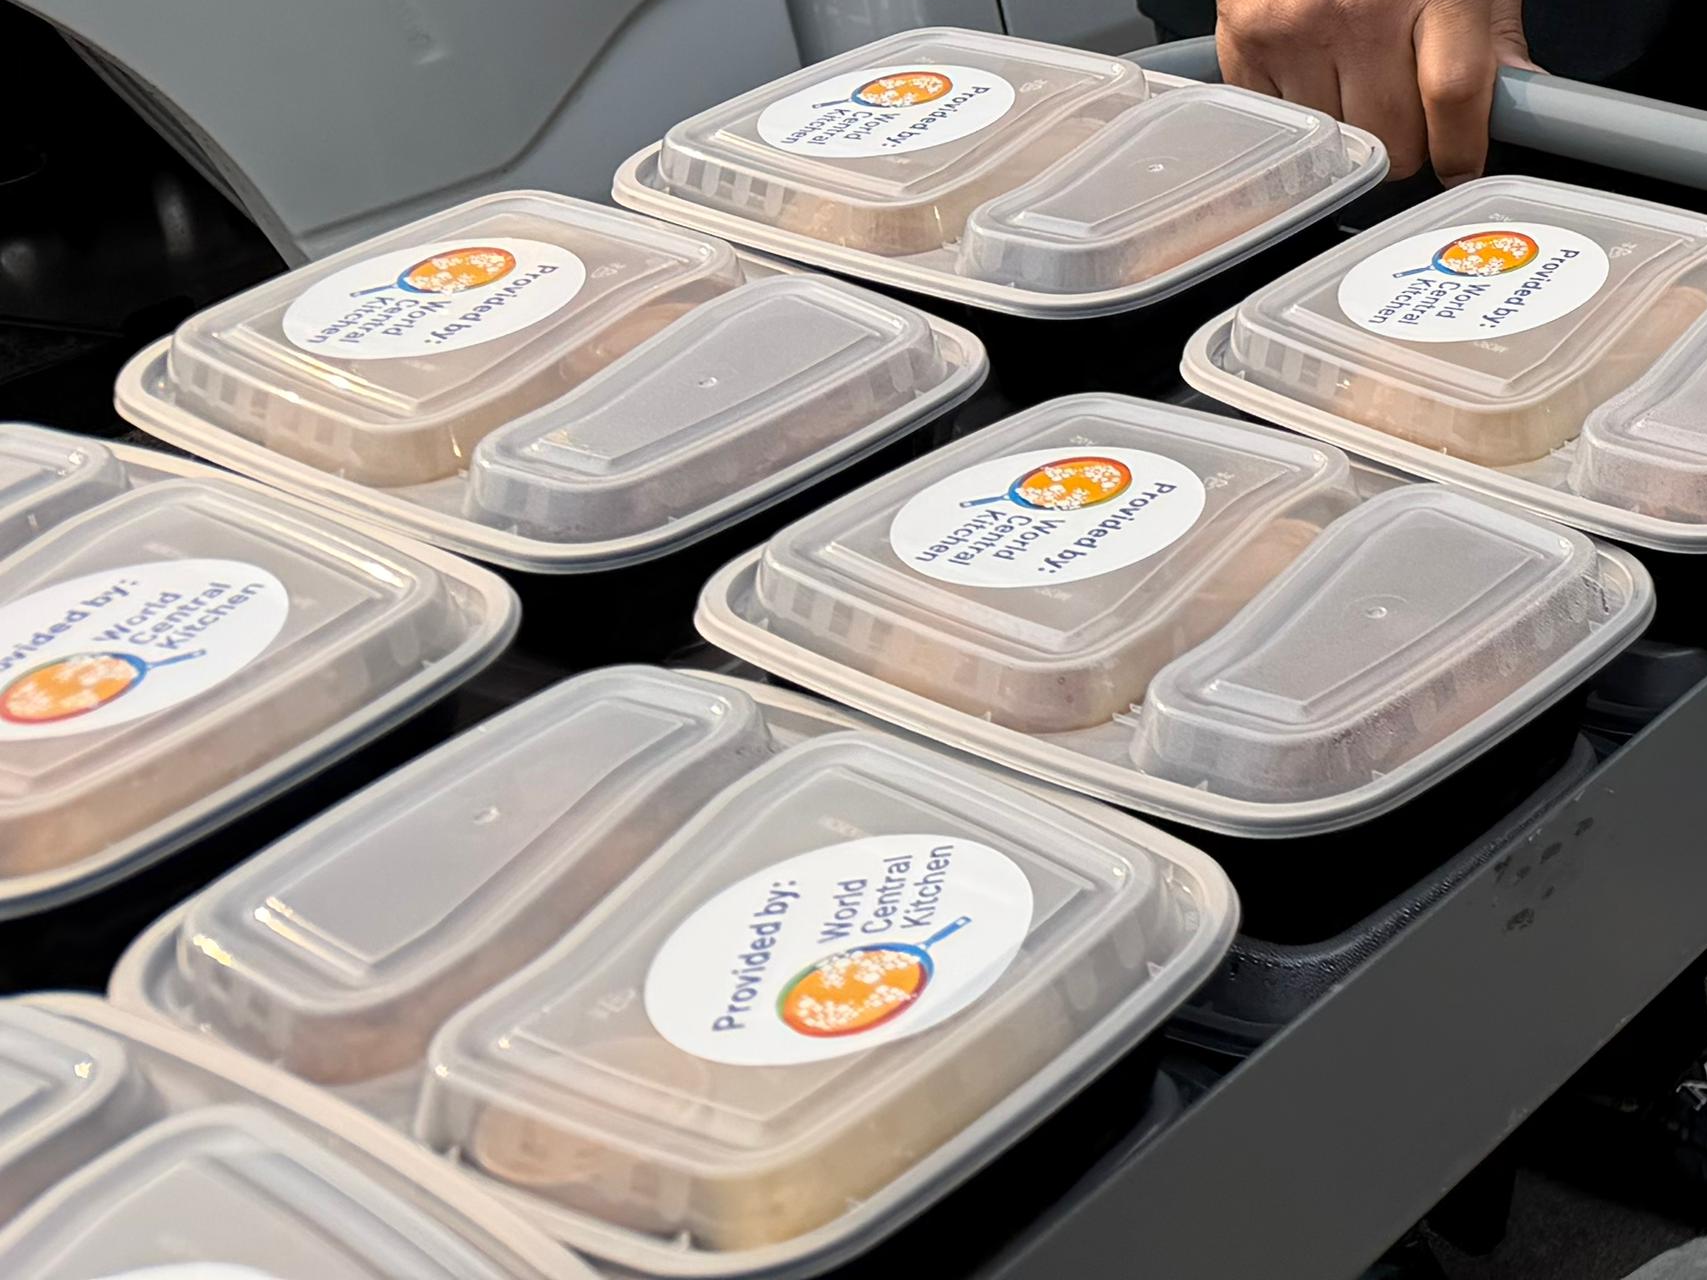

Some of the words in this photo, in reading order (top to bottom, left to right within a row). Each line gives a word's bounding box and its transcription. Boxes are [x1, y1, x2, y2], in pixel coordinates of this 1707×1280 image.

[778, 108, 851, 144] Kitchen
[806, 110, 873, 145] Central
[842, 112, 900, 140] World
[907, 86, 991, 130] Provided
[880, 130, 921, 147] by:
[457, 264, 559, 322] Provided
[1367, 277, 1436, 324] Kitchen
[1434, 283, 1490, 318] World
[1502, 248, 1581, 306] Provided
[305, 296, 395, 343] Kitchen
[338, 298, 420, 343] Central
[380, 300, 450, 336] World
[1396, 281, 1461, 325] Central
[1478, 306, 1518, 328] by:
[423, 323, 471, 344] by:
[914, 509, 1006, 562] Kitchen
[1072, 482, 1178, 549] Provided
[947, 514, 1032, 566] Central
[991, 519, 1064, 560] World
[1036, 548, 1086, 573] by:
[92, 591, 182, 642] World
[128, 581, 232, 645] Central
[155, 582, 265, 650] Kitchen
[818, 877, 869, 943] World
[860, 855, 914, 933] Central
[900, 845, 956, 928] Kitchen
[711, 920, 783, 1031] Provided
[753, 880, 801, 917] by:
